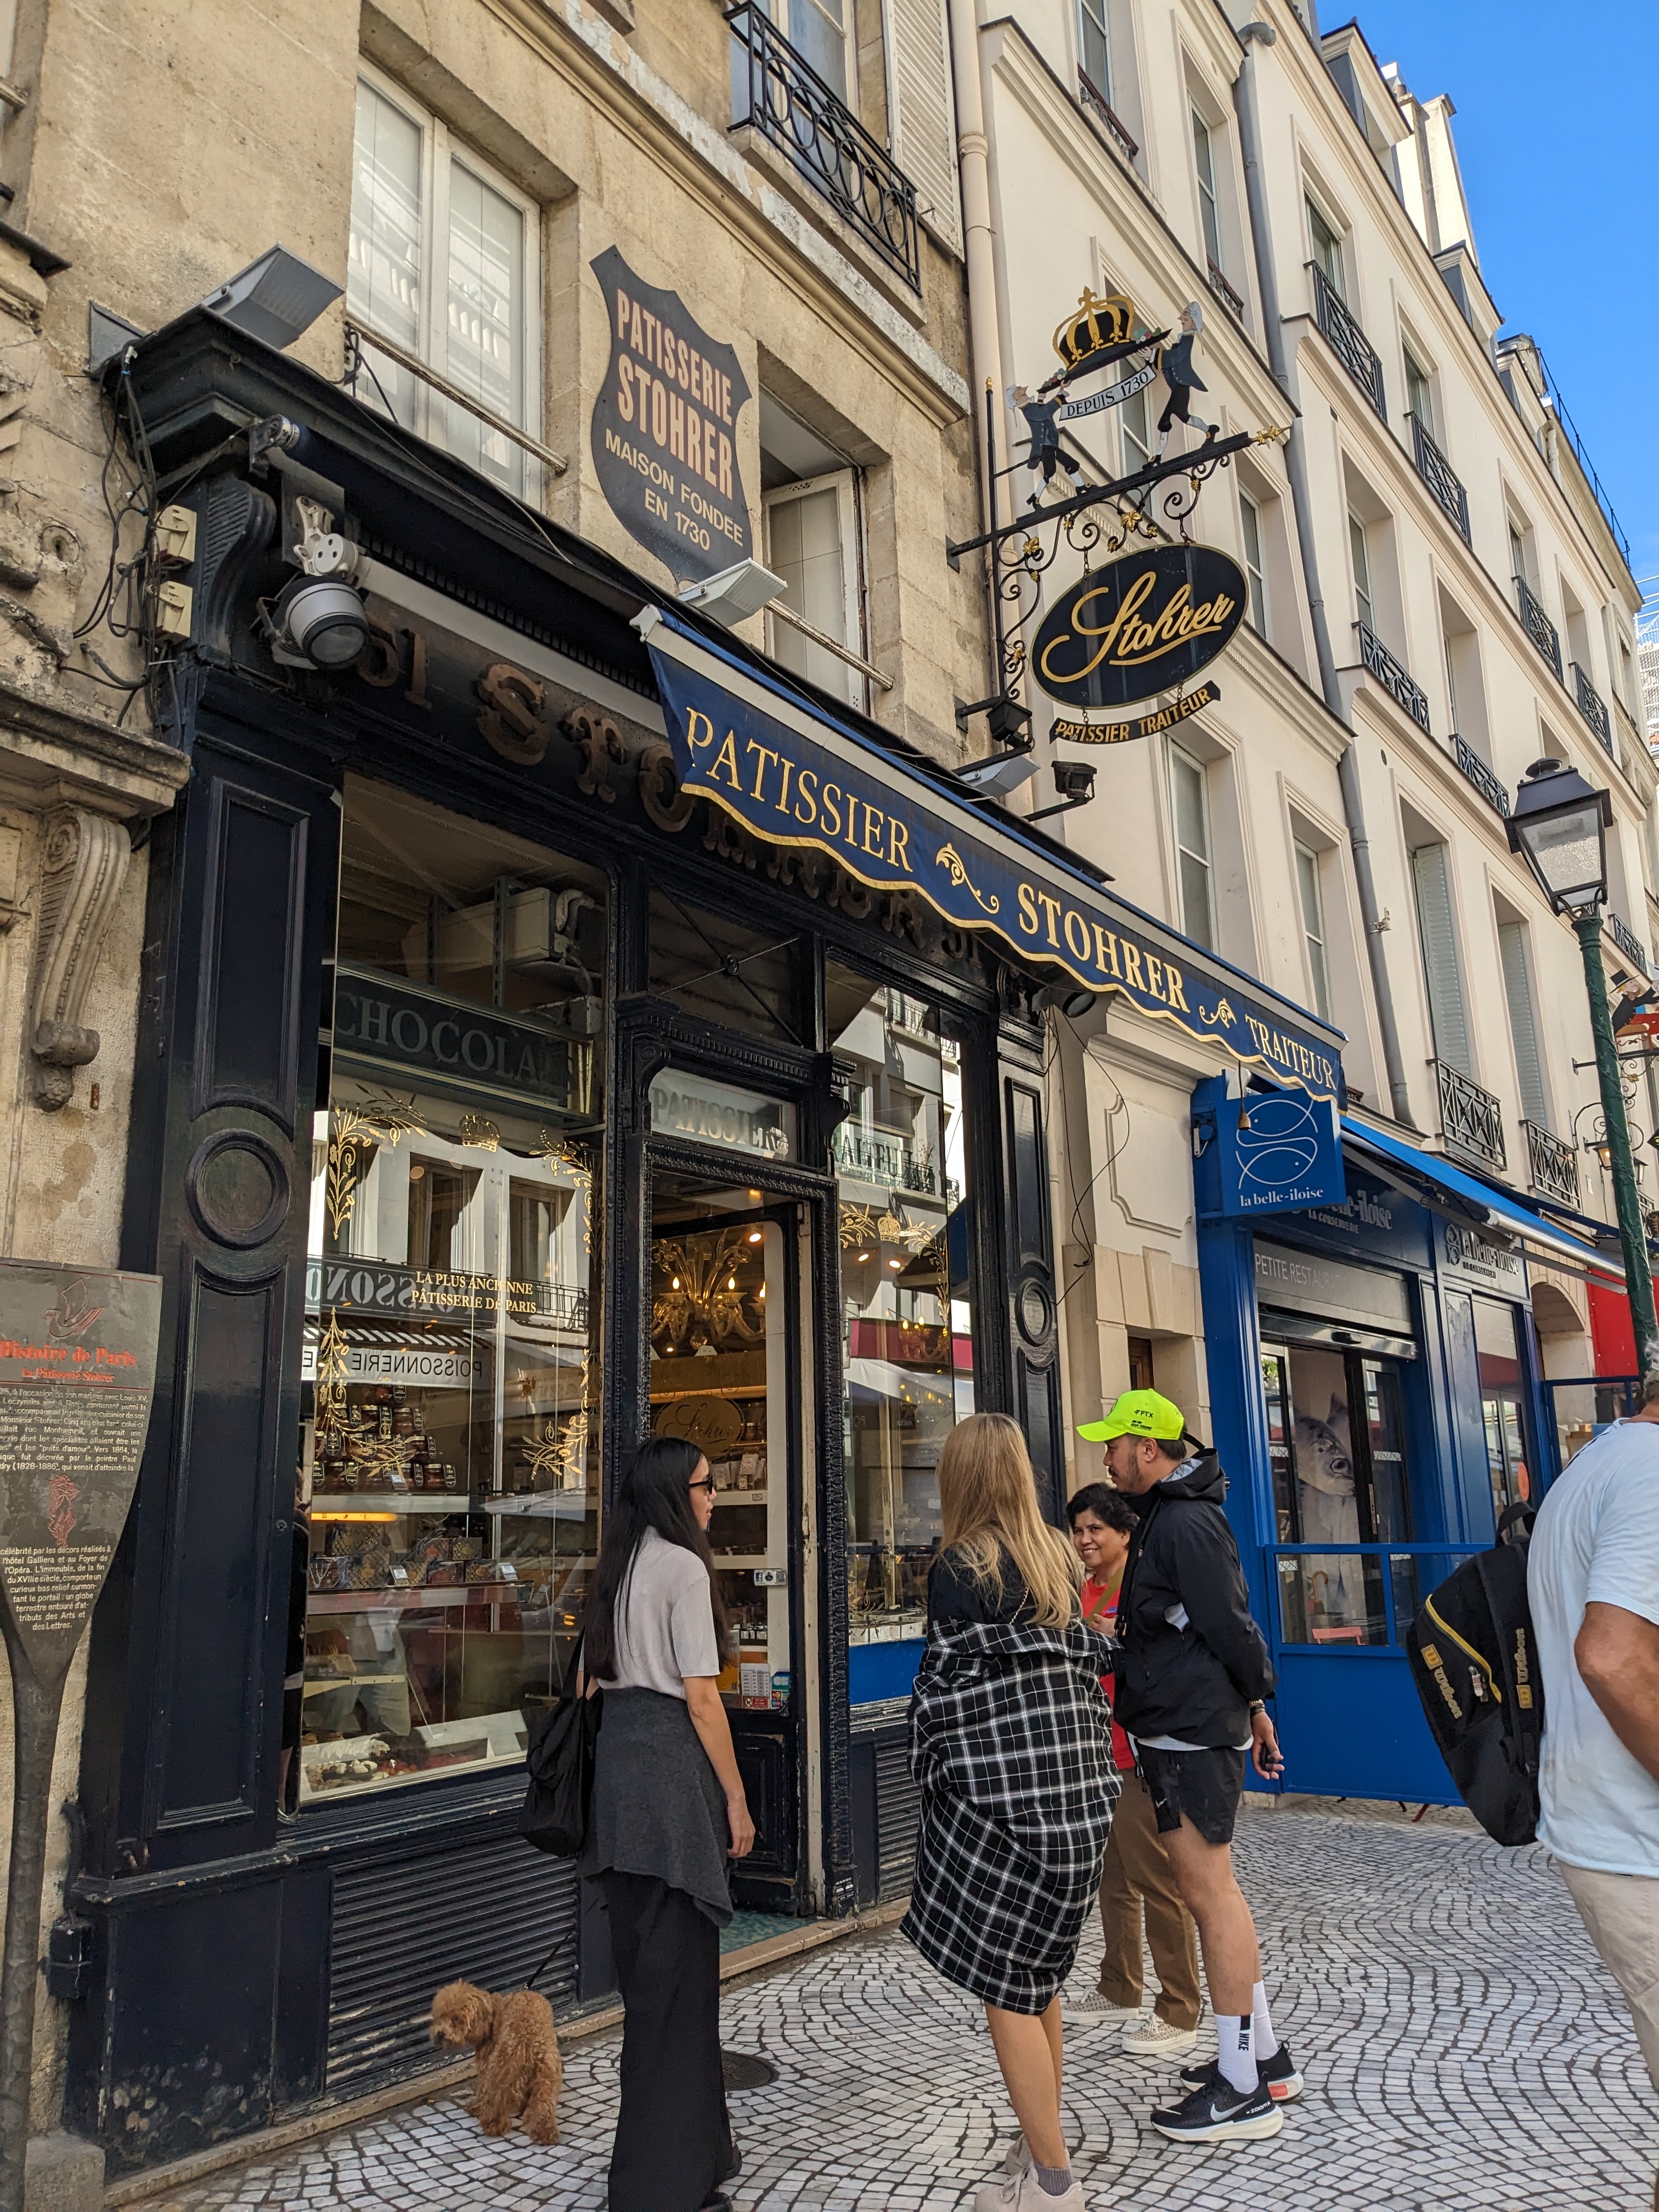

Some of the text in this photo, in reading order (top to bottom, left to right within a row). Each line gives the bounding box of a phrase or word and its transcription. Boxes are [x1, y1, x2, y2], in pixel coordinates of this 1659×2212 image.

[617, 289, 732, 427] PATISSERIE
[1067, 371, 1149, 416] DEPUIS 1730
[618, 353, 733, 501] STOHRER
[606, 428, 743, 548] MAISON FONDÉE
[645, 487, 710, 551] EN 1730
[1041, 572, 1235, 683] Stohrer
[1054, 688, 1211, 743] PATISSIER TRAITEUR
[686, 706, 1337, 1091] PATISSIER STOHRER TRAITEUR
[1240, 1187, 1324, 1206] la belle-iloise
[1255, 1253, 1288, 1280] PETITE
[416, 1271, 533, 1295] LA PLUS ANCIENNE
[411, 1288, 537, 1313] PÂTISSERIE DE PARIS
[0, 1340, 137, 1366] Histoire de Paris
[22, 1367, 33, 1378] La
[0, 1387, 12, 1396] 25,
[19, 1388, 54, 1397] l'occasion
[138, 1395, 148, 1403] XV,
[21, 1434, 36, 1442] dont
[53, 1436, 88, 1444] spécialités
[0, 1462, 11, 1471] dry
[61, 1463, 72, 1471] qui
[36, 1453, 64, 1461] décorée
[96, 1454, 118, 1463] peintre
[0, 1547, 32, 1556] célébrité
[33, 1548, 45, 1556] par
[3, 1556, 24, 1565] l'hôtel
[78, 1554, 98, 1564] Foyer
[40, 1574, 63, 1583] siècle,
[62, 1573, 93, 1582] comporte
[52, 1583, 70, 1592] relief
[38, 1593, 60, 1603] portail
[75, 1592, 94, 1602] globe
[15, 1604, 47, 1612] terrestre
[45, 1612, 58, 1621] des
[78, 1610, 86, 1618] et
[46, 1621, 73, 1630] Lettres.
[1238, 2033, 1250, 2051] NIKE
